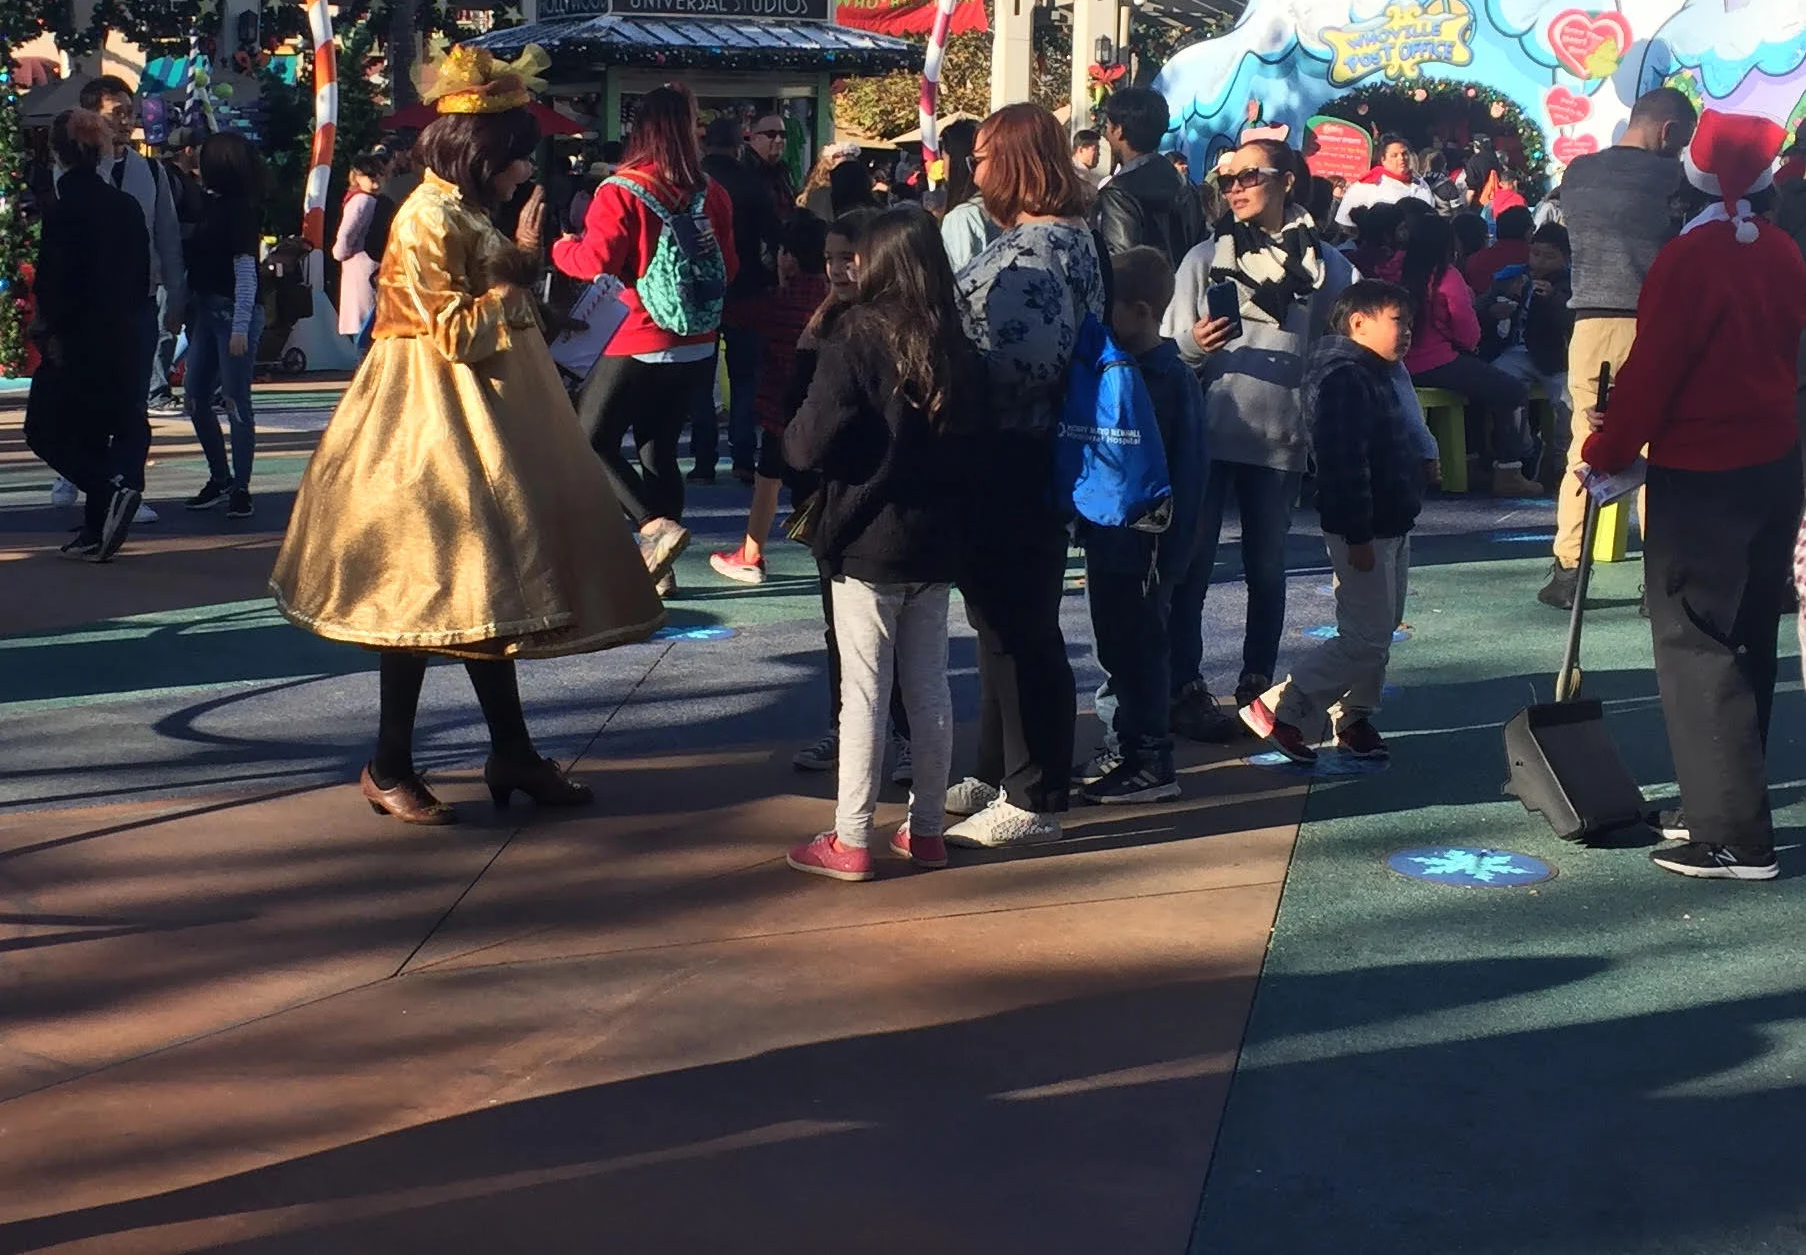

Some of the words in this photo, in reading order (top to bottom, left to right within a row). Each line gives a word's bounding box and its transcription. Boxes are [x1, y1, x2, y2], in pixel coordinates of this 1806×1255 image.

[1346, 23, 1441, 48] WHOVILLE
[1343, 43, 1395, 73] POST
[1399, 39, 1456, 62] OFFICE
[1106, 435, 1142, 445] Hospital
